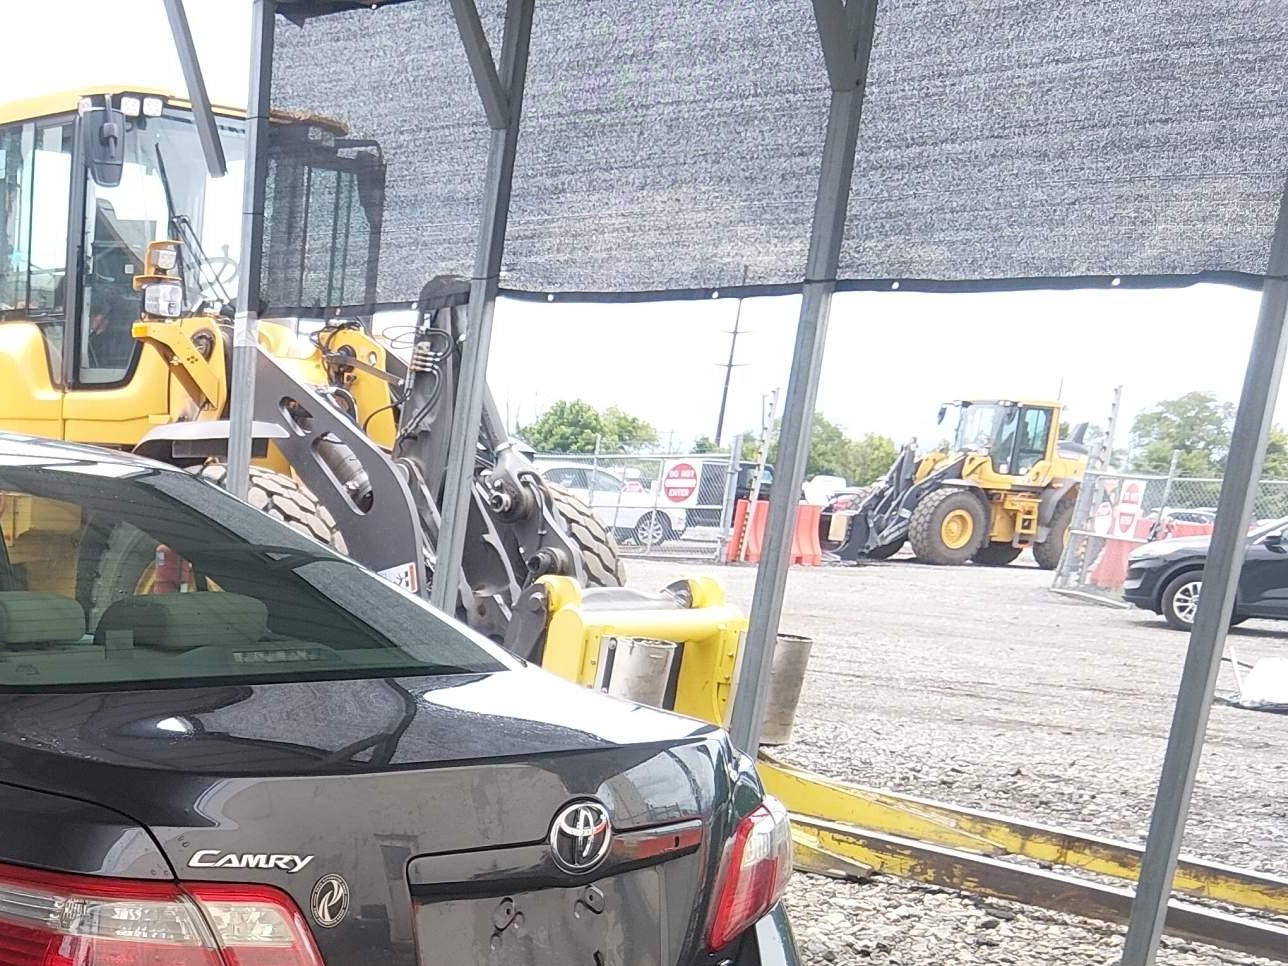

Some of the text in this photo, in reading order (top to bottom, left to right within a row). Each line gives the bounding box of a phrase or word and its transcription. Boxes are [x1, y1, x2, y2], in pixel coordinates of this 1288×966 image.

[668, 469, 696, 478] DO NOT
[668, 488, 690, 497] ENTER
[188, 850, 314, 873] CAMRY
